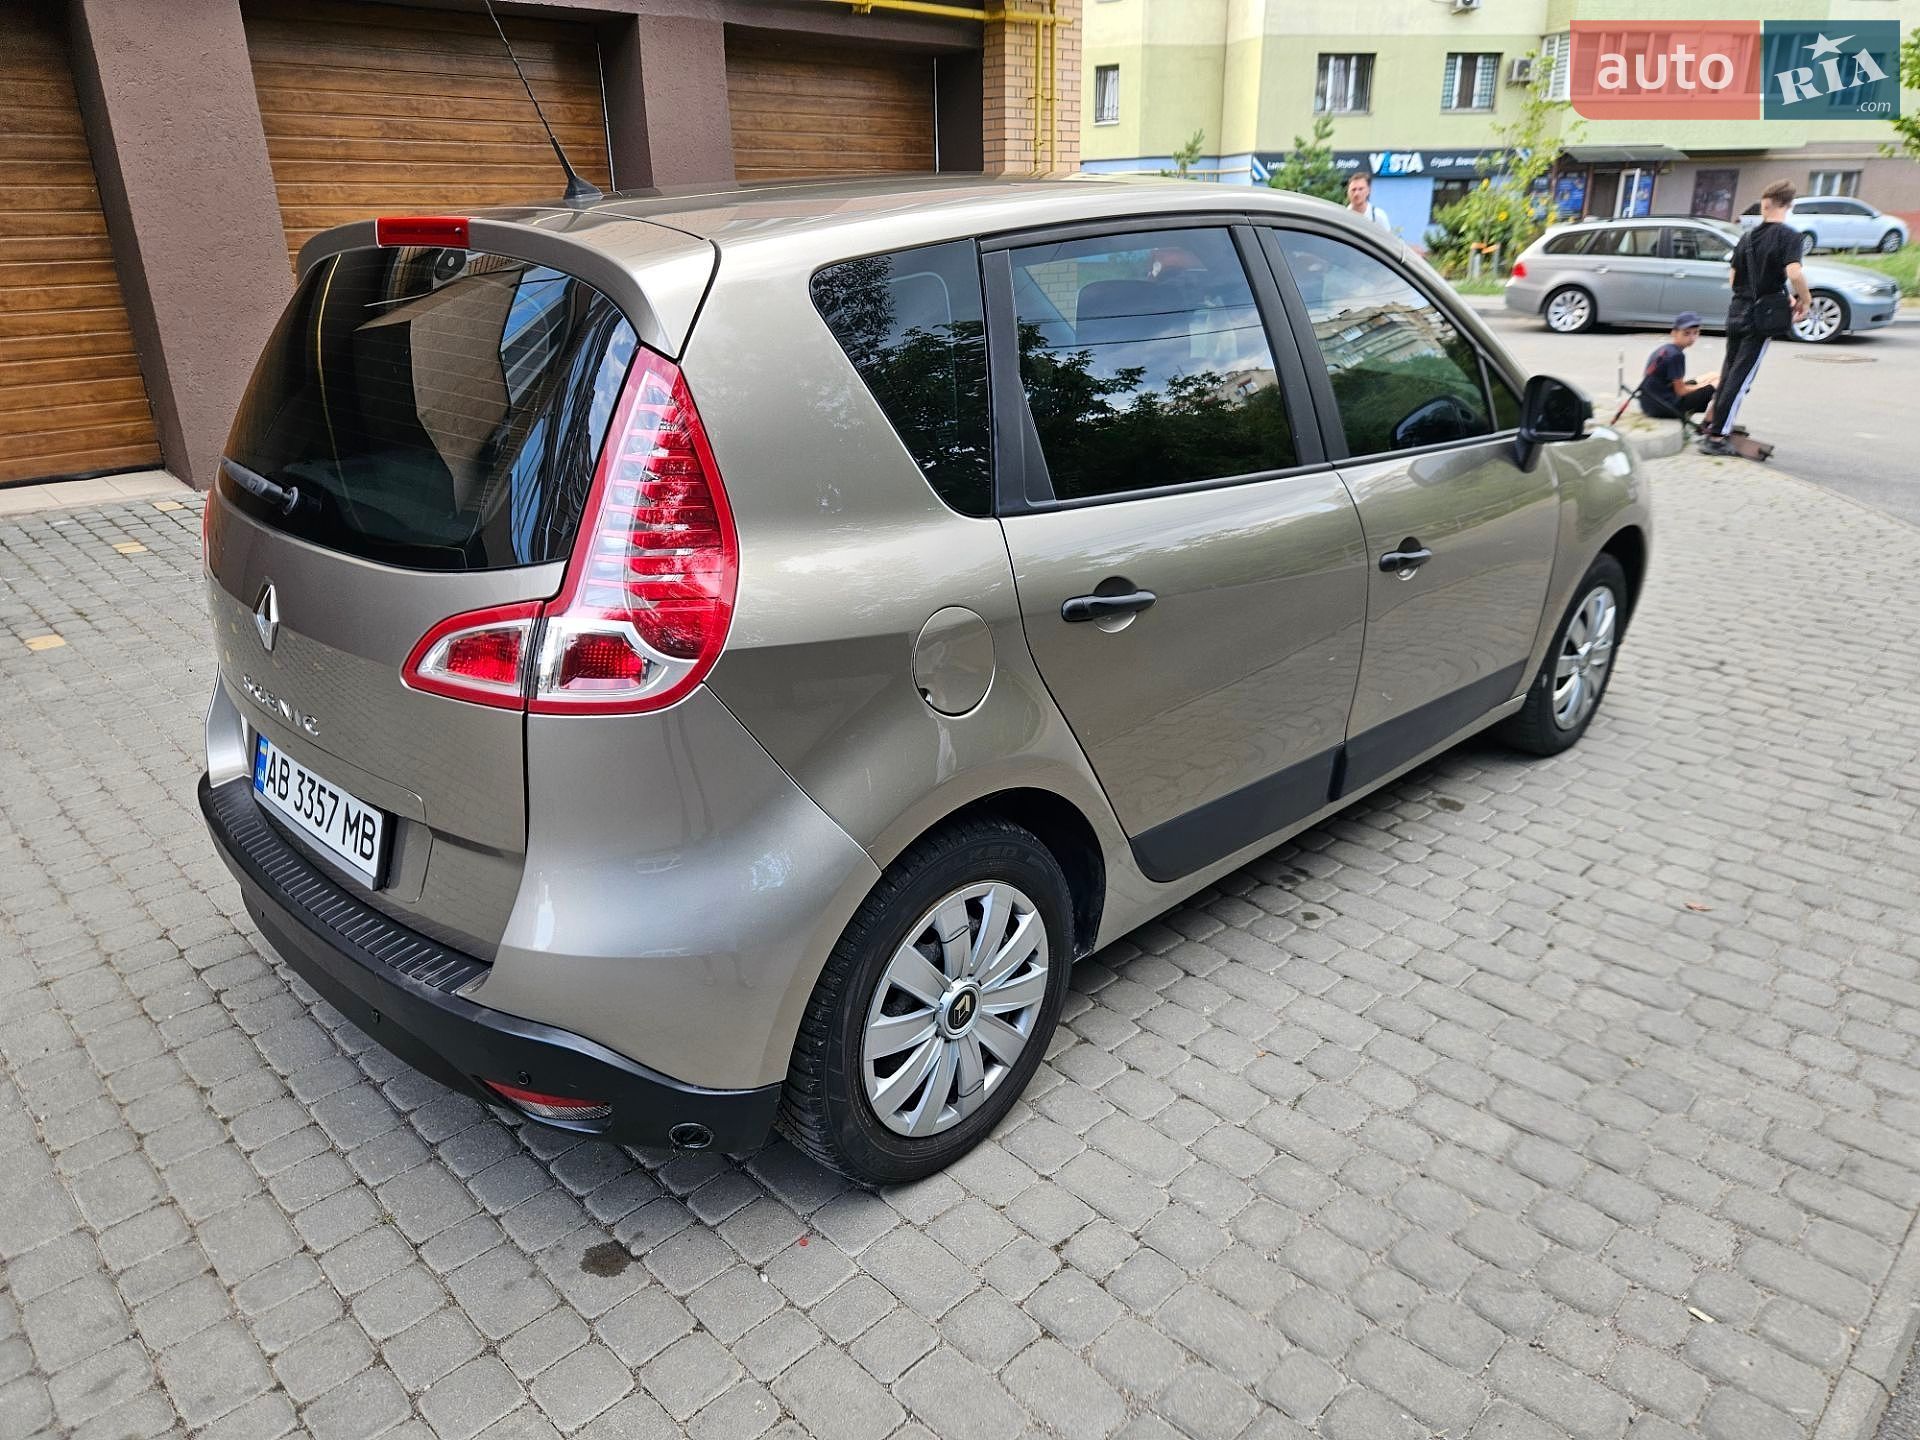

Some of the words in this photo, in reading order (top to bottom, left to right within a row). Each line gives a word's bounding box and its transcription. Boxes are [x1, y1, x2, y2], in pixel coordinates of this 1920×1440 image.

[242, 673, 320, 737] SCENIC
[265, 751, 291, 801] AB
[293, 769, 339, 834] 3357
[342, 802, 377, 861] MB
